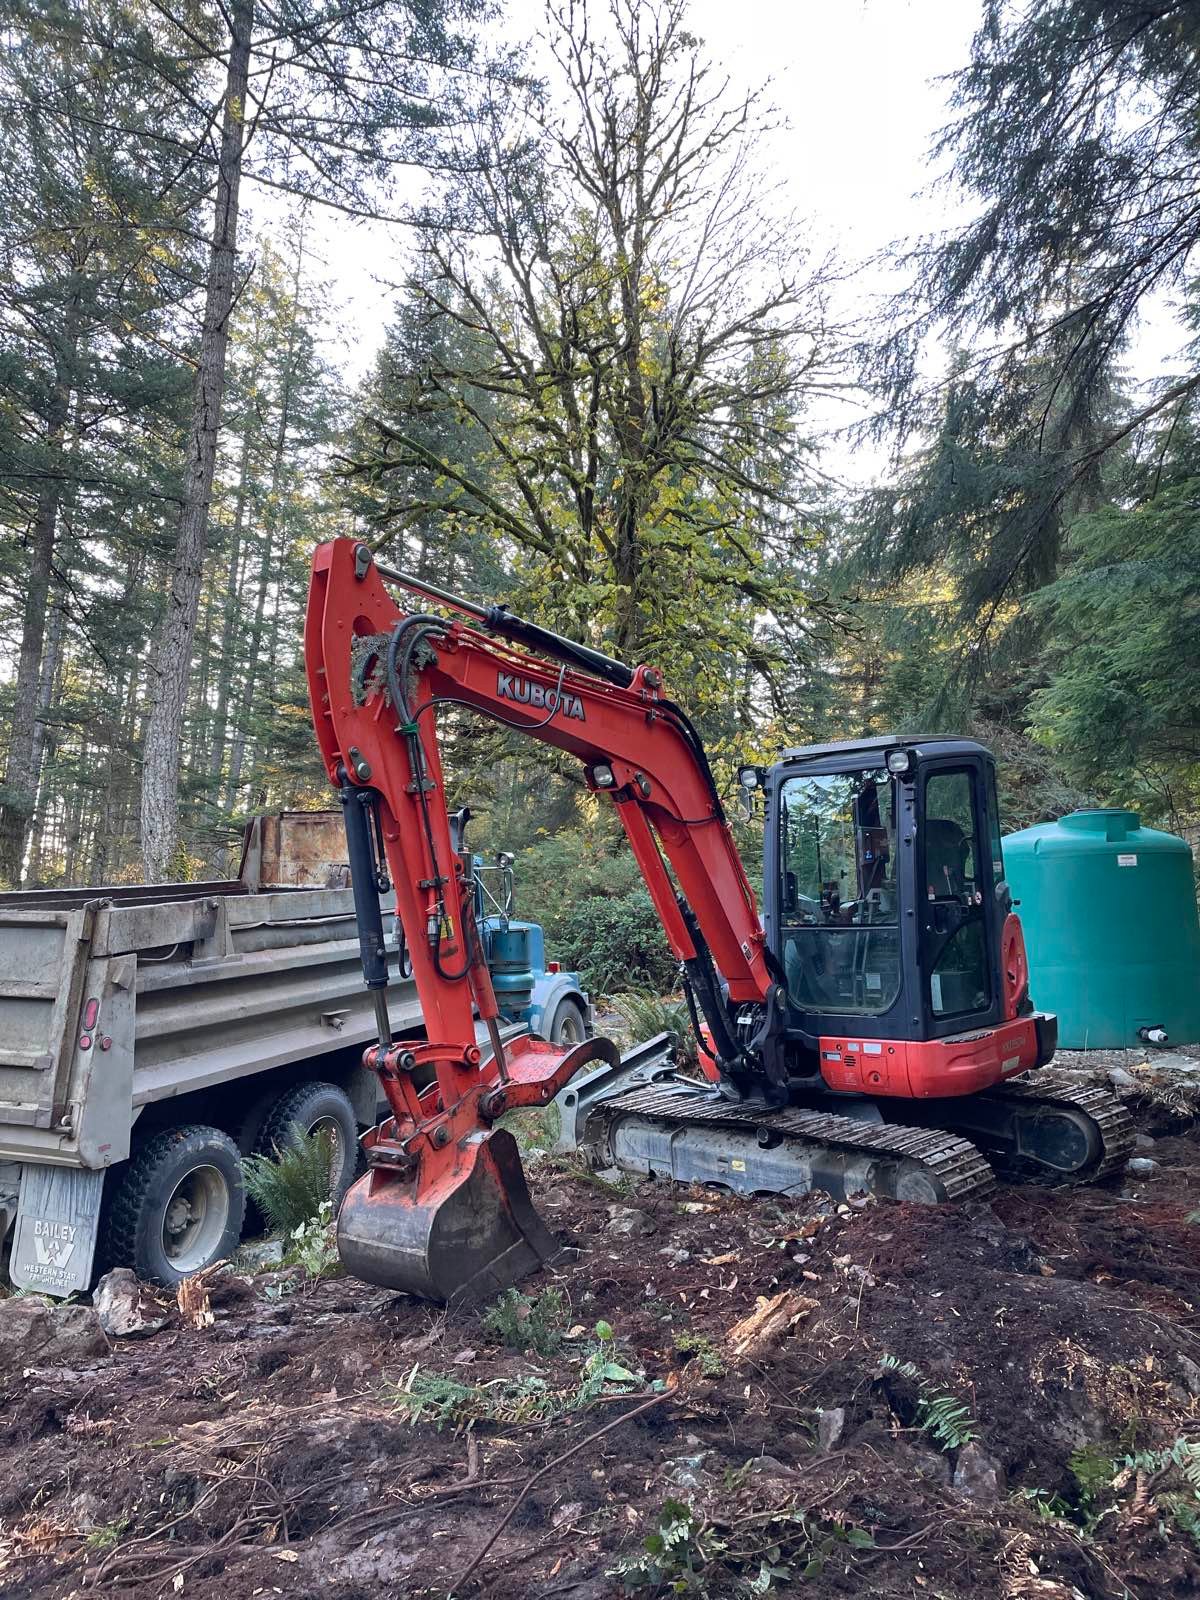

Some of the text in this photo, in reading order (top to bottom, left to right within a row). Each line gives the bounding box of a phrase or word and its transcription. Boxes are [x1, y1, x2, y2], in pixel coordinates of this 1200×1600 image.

[497, 671, 586, 721] KUBOTA
[34, 1220, 77, 1243] BAILEY
[23, 1263, 77, 1281] WESTERN STAR
